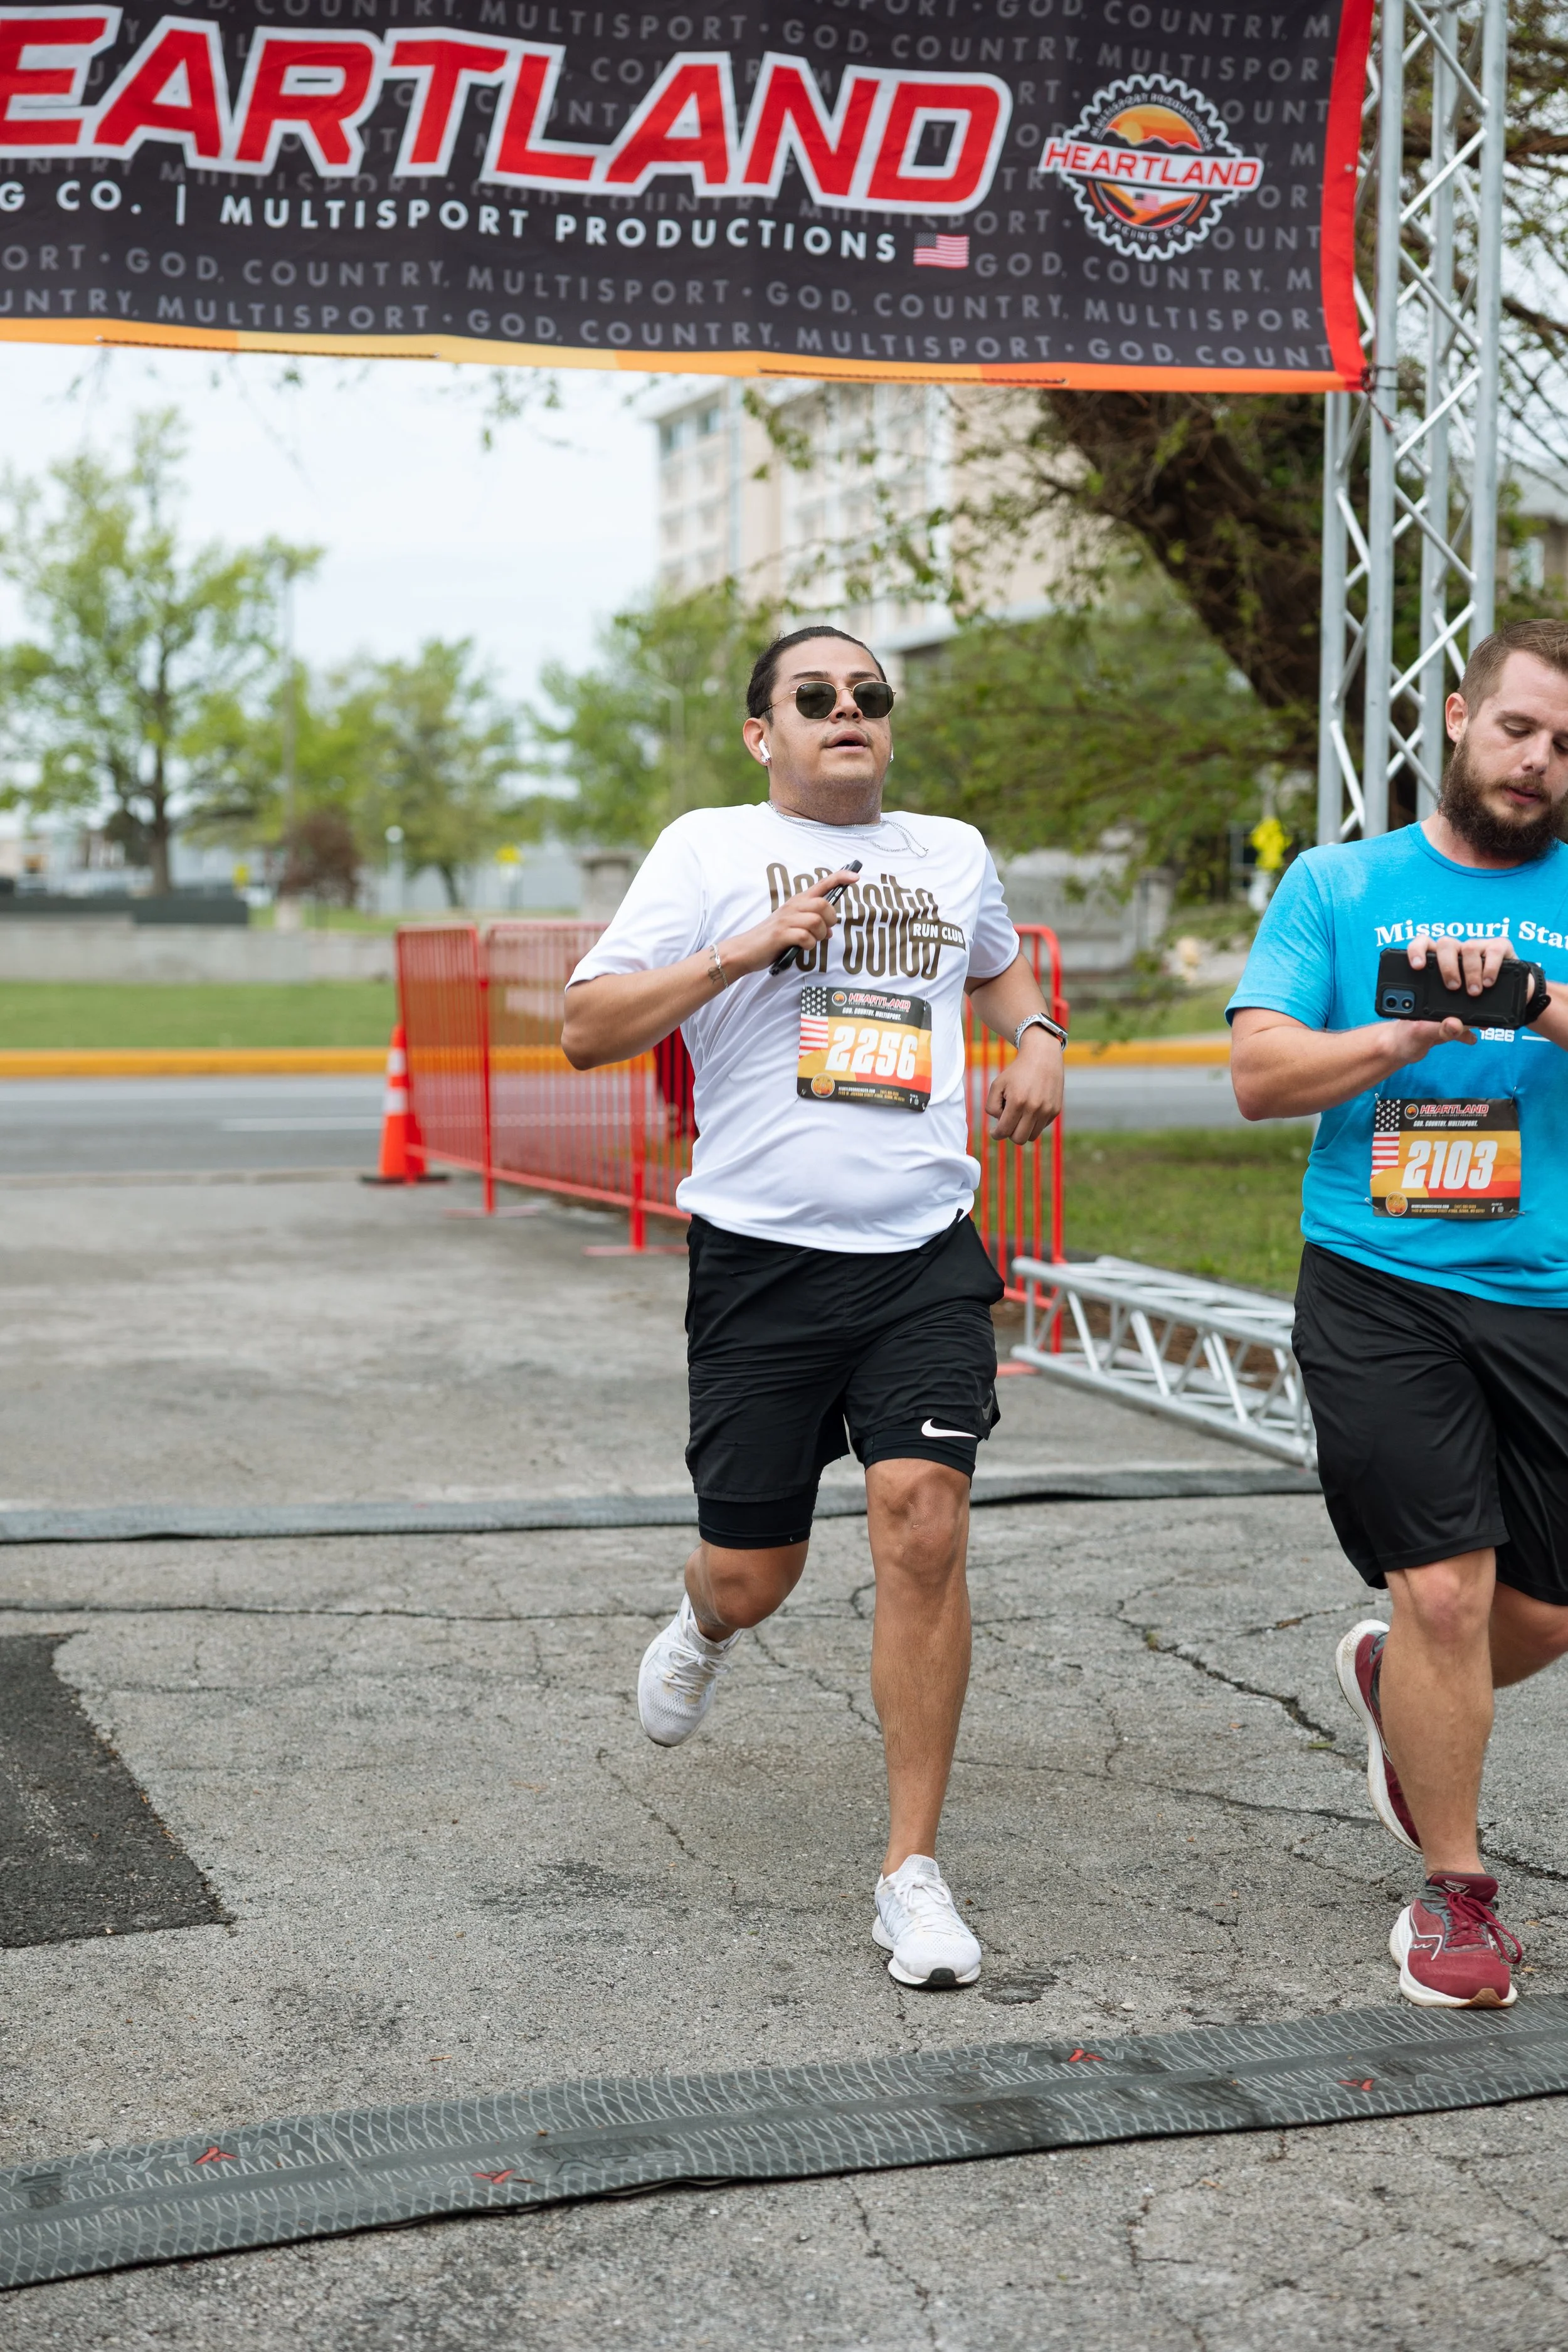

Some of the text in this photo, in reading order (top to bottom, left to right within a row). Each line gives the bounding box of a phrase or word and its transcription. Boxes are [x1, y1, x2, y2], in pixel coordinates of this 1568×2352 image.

[479, 3, 748, 41] MULTISPORT
[0, 5, 1013, 215] EARTLAND
[1046, 140, 1259, 187] HEARTLAND
[56, 180, 142, 215] CO.
[220, 195, 529, 238] MULTISPORT
[554, 213, 896, 263] PRODUCTIONS
[466, 265, 731, 305] MULTISPORT
[1084, 298, 1328, 332] MULTISPOR
[156, 294, 430, 329] MULTISPORT
[795, 326, 1052, 359] MULTISPORT
[913, 923, 964, 944] RUN CLUB
[1374, 917, 1510, 947] Missouri
[848, 992, 911, 1010] HEARTLAND
[825, 1025, 918, 1081] 2256
[1419, 1104, 1489, 1115] HEARTLAND
[1401, 1140, 1498, 1189] 2103
